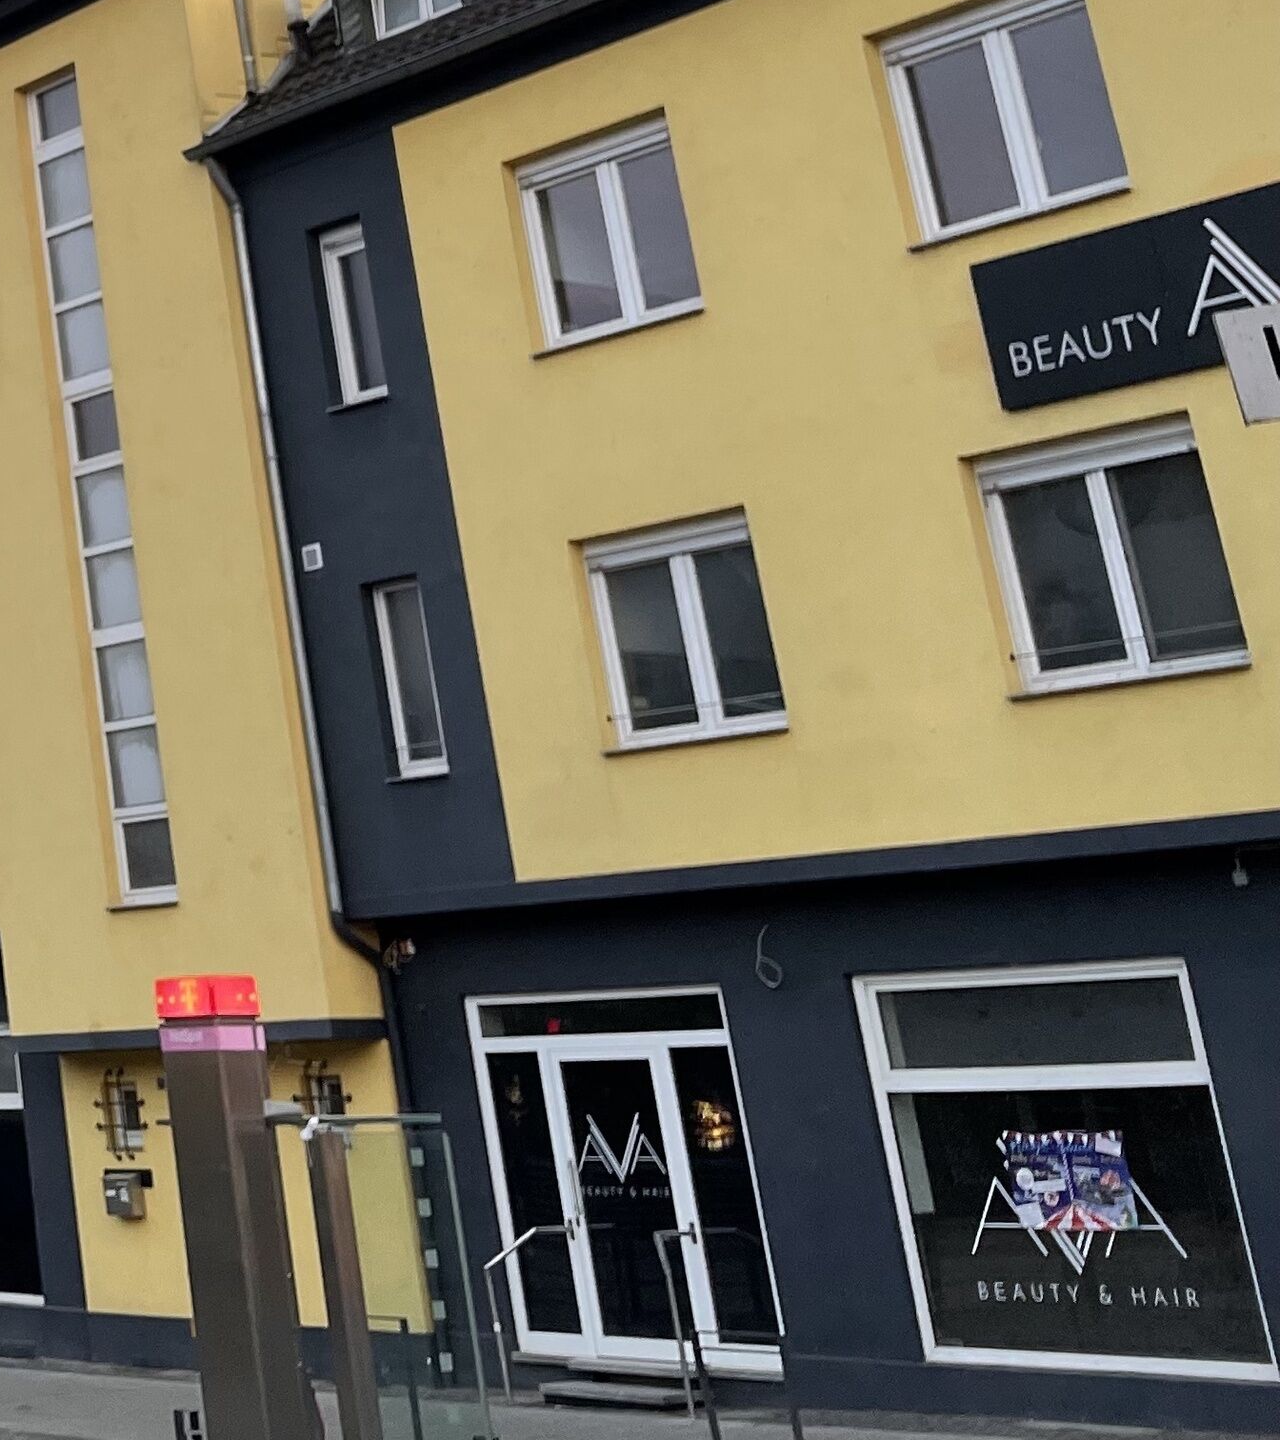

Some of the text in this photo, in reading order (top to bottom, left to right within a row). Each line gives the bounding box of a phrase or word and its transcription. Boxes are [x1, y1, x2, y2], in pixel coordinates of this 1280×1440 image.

[1008, 308, 1162, 378] BEAUTY
[977, 1280, 1201, 1309] BEAUTY & HAIR
